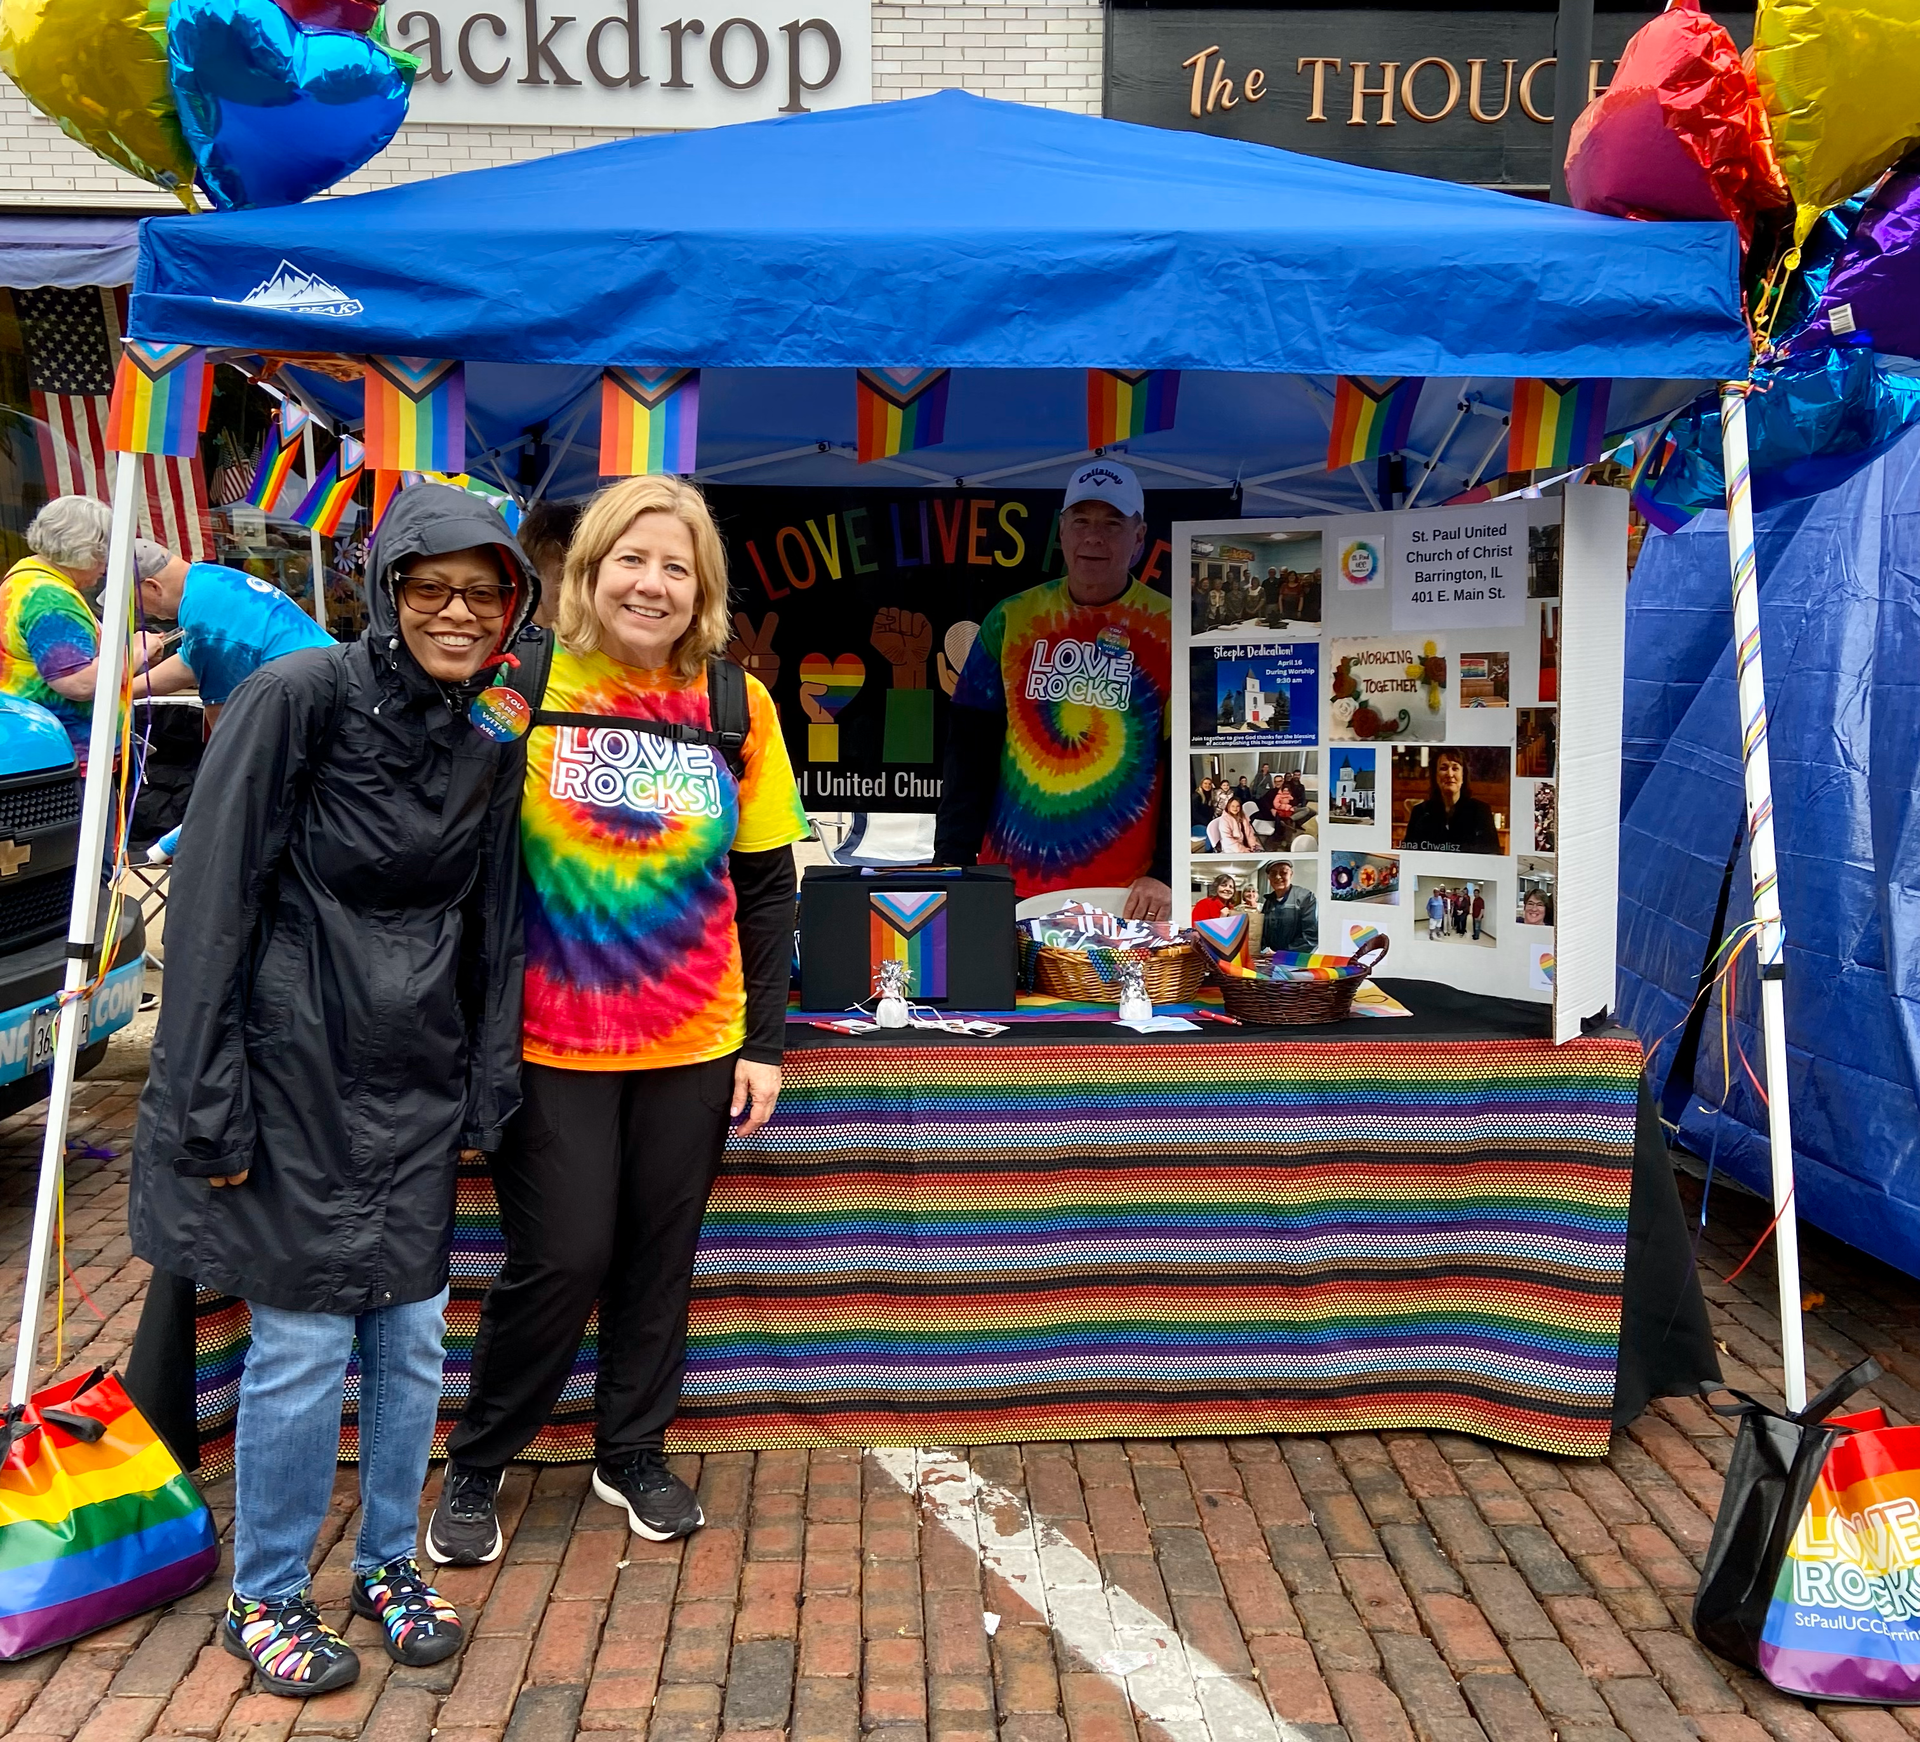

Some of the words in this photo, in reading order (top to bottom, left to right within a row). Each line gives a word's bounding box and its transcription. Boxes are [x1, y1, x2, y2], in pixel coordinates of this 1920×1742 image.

[1182, 45, 1267, 118] The
[1079, 467, 1123, 484] Callaway
[1412, 531, 1428, 543] St.
[1432, 527, 1461, 541] Paul
[1465, 523, 1507, 539] United
[746, 507, 879, 600] LOVE
[890, 499, 1028, 568] LIVES
[1406, 549, 1452, 563] Church
[1457, 547, 1470, 560] of
[1473, 545, 1513, 559] Christ
[1415, 567, 1487, 584] Barrington,
[1491, 566, 1503, 579] IL
[1411, 591, 1434, 603] 401
[1438, 590, 1450, 602] E.
[1454, 588, 1484, 601] Main
[1488, 587, 1506, 599] St.
[1029, 638, 1134, 684] LOVE
[1214, 645, 1245, 662] Steeple
[1247, 644, 1293, 658] Dedication!
[1357, 649, 1413, 666] WORKING
[1277, 659, 1293, 667] April
[1288, 667, 1315, 676] Worship
[1025, 672, 1131, 711] ROCKS!
[1363, 678, 1418, 694] TOGETHER
[497, 701, 518, 718] ARE
[505, 693, 525, 710] YOU
[482, 711, 507, 733] WITH
[489, 706, 513, 727] SAFE
[479, 723, 496, 737] ME
[555, 726, 717, 778] LOVE
[550, 761, 723, 818] ROCKS!
[816, 771, 887, 797] United
[1396, 840, 1418, 850] Jana
[1420, 840, 1461, 852] Chwalisz
